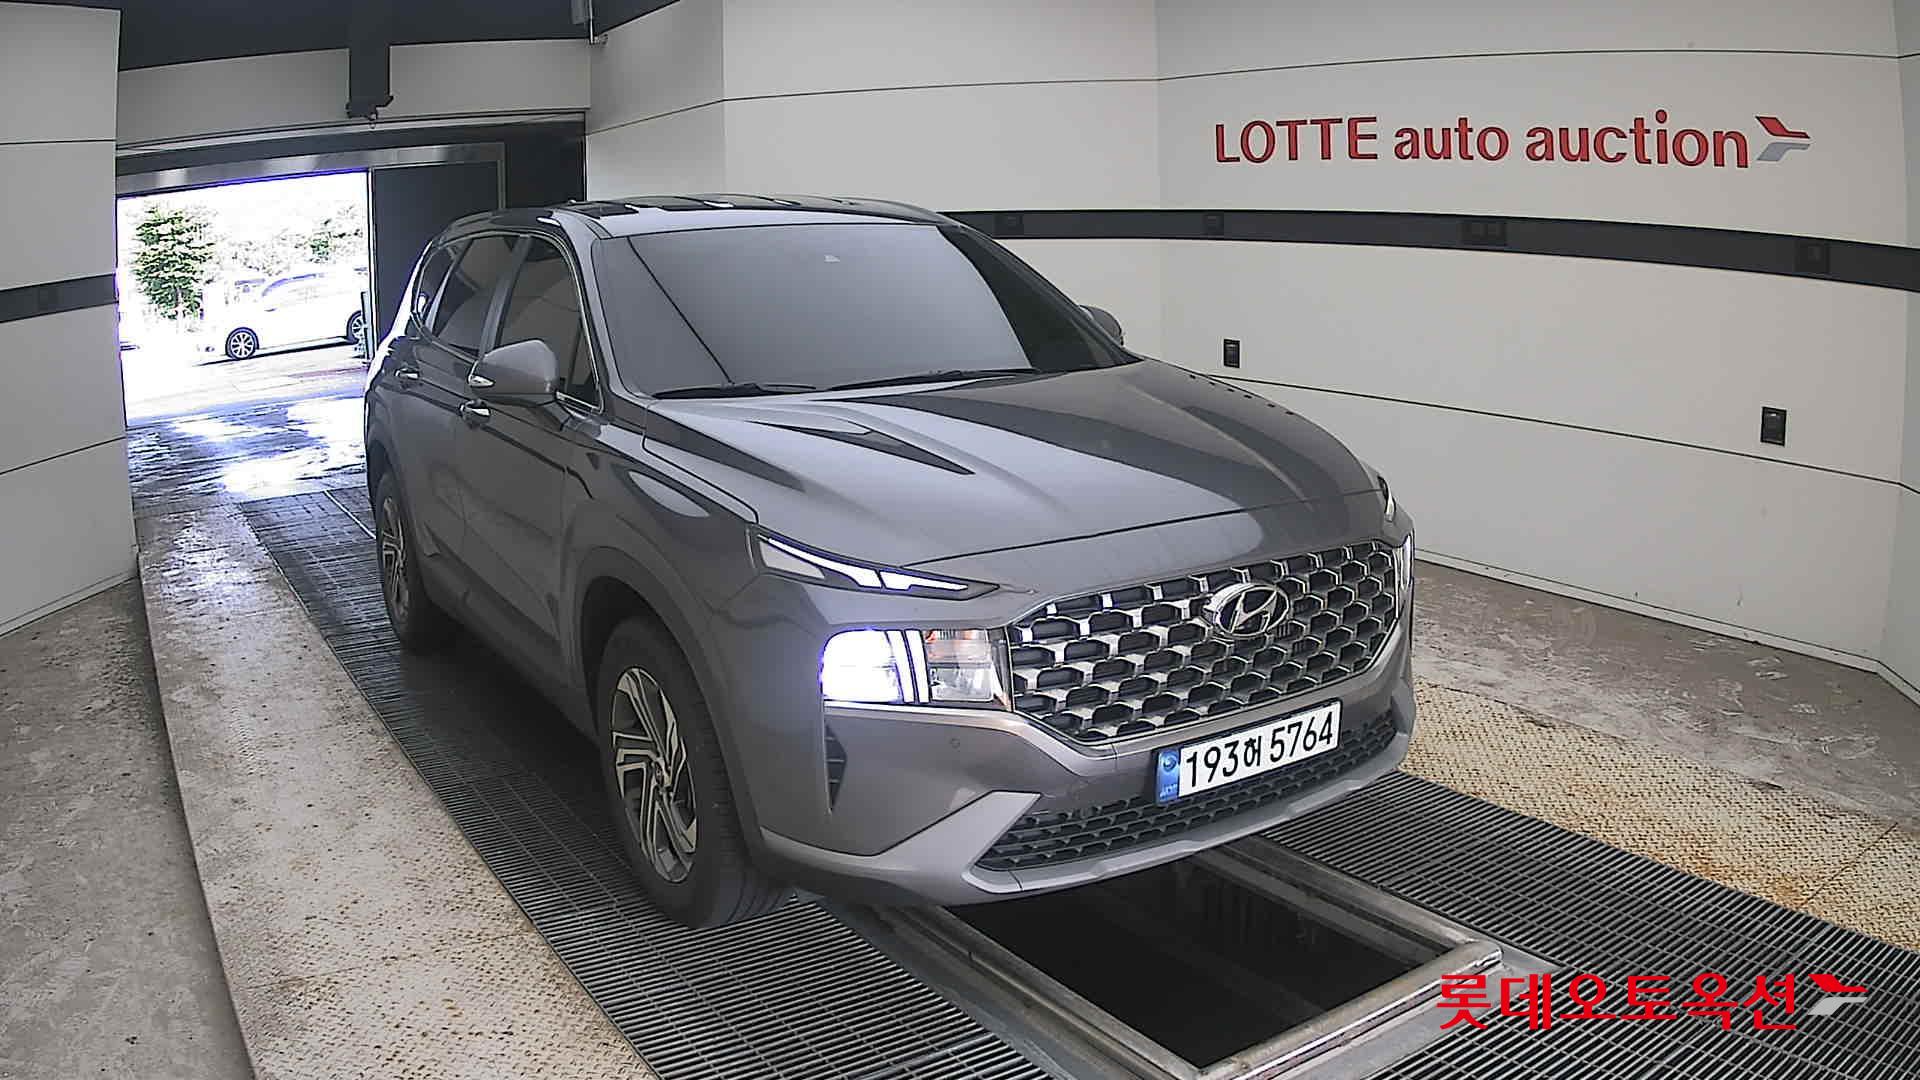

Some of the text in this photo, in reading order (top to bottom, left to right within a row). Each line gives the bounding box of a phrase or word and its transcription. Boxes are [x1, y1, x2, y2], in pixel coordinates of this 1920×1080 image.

[1215, 109, 1748, 168] LOTTE auto auction
[1269, 711, 1333, 763] 5764
